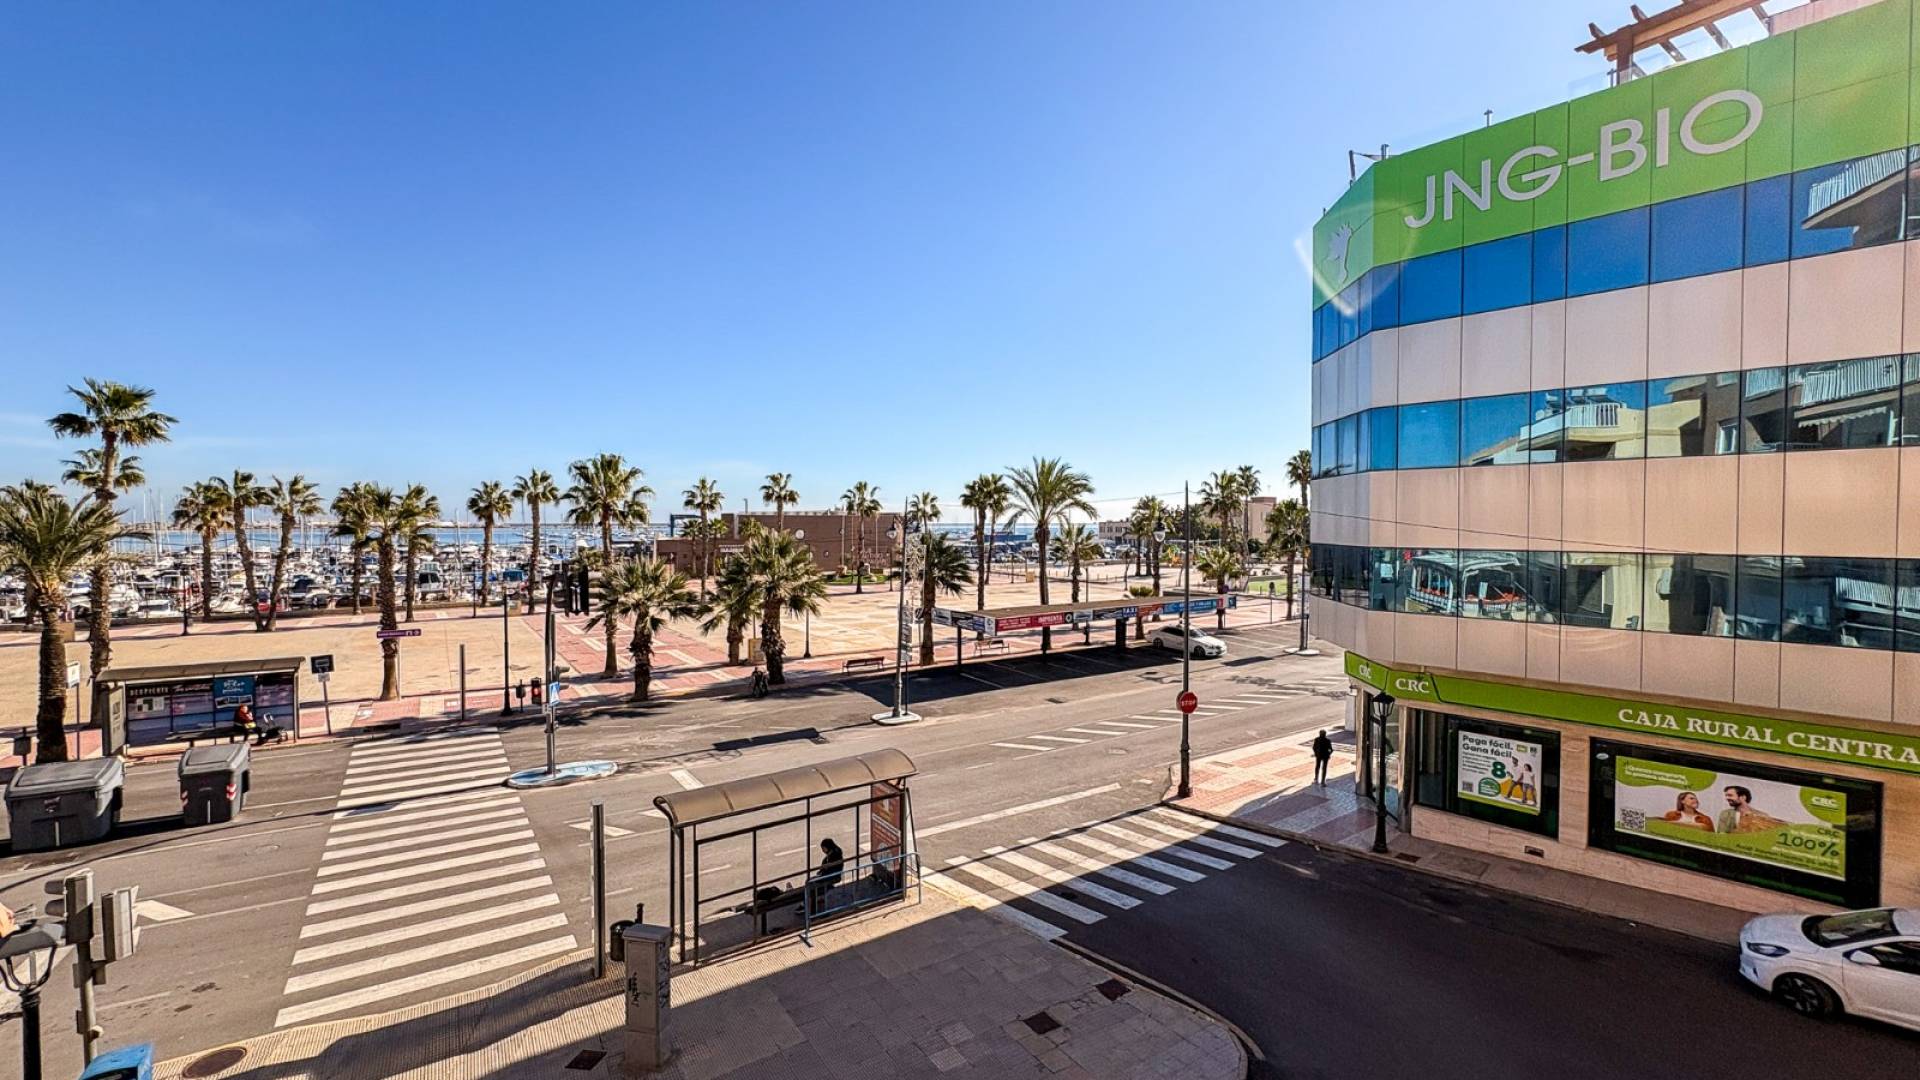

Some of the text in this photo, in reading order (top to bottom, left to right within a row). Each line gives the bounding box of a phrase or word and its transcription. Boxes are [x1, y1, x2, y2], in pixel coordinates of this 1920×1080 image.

[1403, 89, 1763, 228] JNG-BIO
[1395, 678, 1430, 694] CRC
[1618, 708, 1680, 730] CAJA
[1686, 717, 1781, 745] RURAL
[1462, 735, 1487, 745] Paga
[1462, 743, 1489, 754] Gana
[1491, 761, 1506, 779] 8
[1811, 796, 1839, 808] CRC
[1816, 826, 1840, 838] CRC
[1776, 832, 1840, 857] 100%
